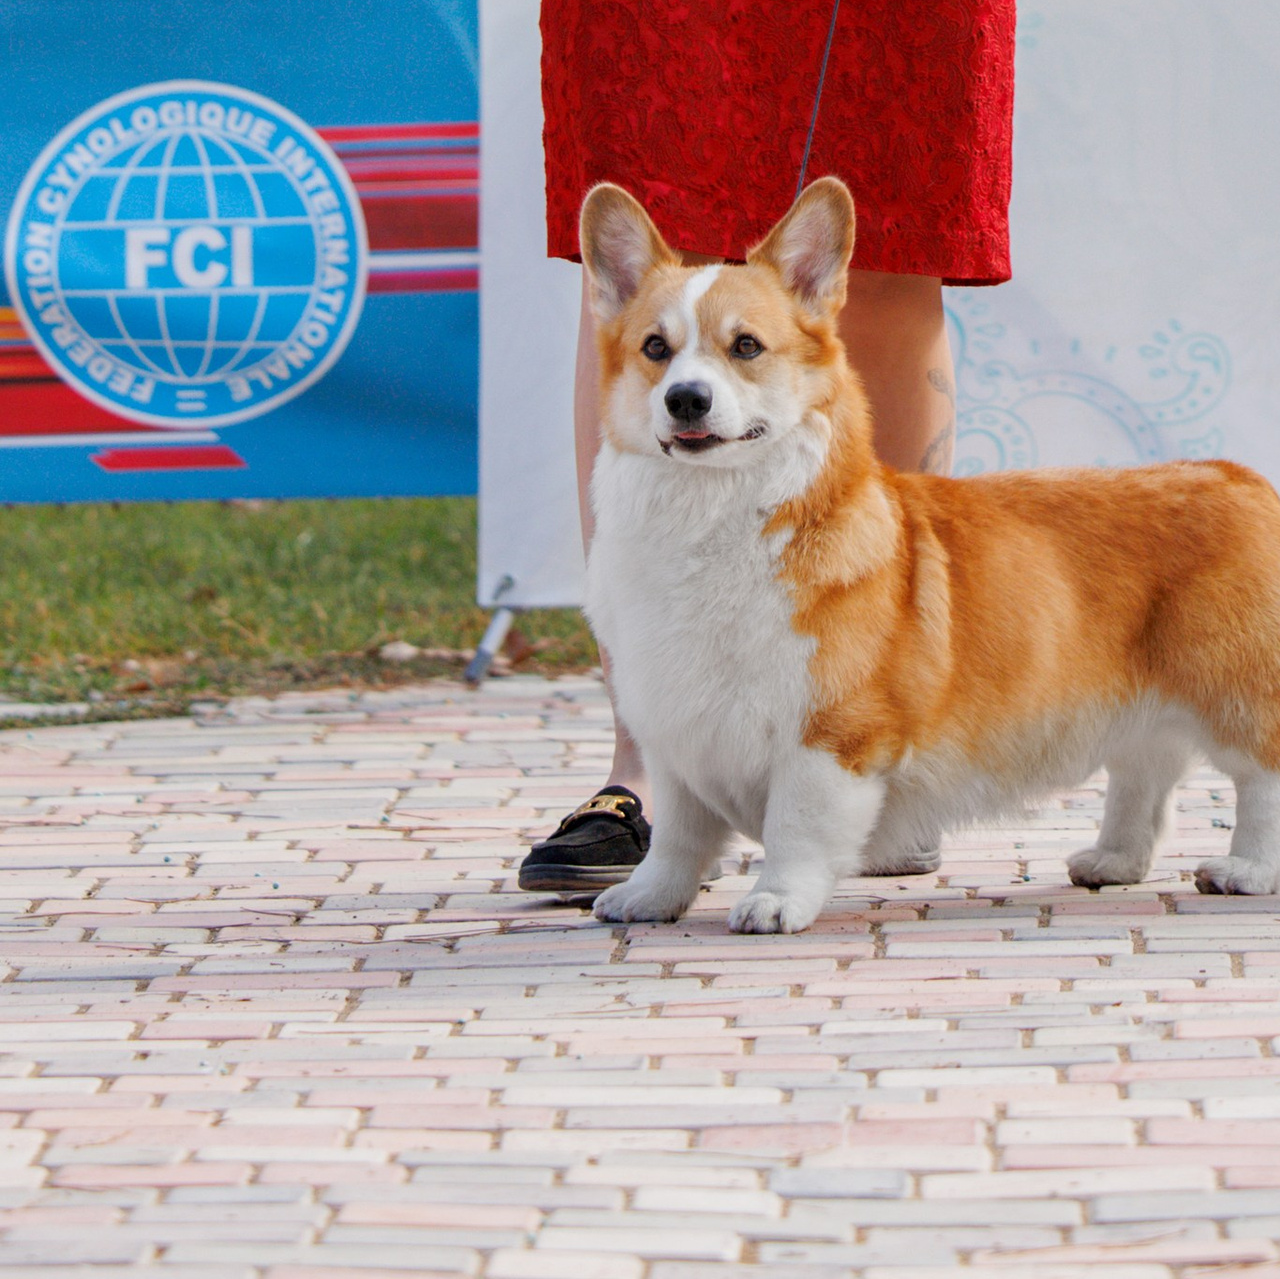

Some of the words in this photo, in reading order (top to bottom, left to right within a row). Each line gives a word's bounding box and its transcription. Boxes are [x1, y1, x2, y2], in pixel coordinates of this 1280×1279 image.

[37, 100, 277, 215] CYNOLOGIQUE
[23, 222, 156, 403] FEDERATION
[124, 227, 254, 289] FCI
[225, 138, 350, 402] INTERNATIONALE
